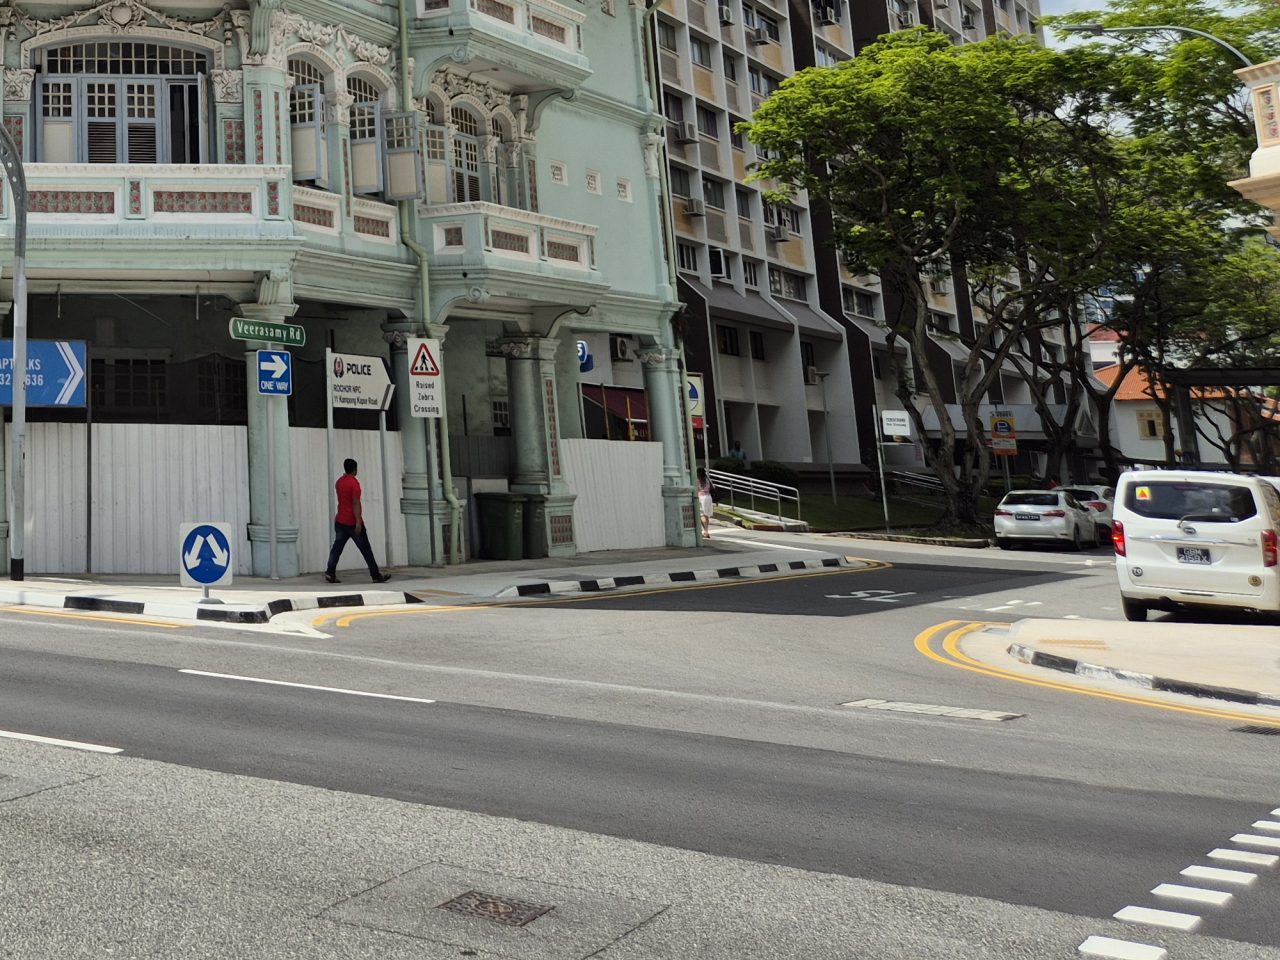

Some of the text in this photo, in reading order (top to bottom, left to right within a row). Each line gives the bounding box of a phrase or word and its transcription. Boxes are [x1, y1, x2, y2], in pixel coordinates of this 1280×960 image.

[237, 320, 301, 341] Veerasamy Rd
[346, 363, 372, 376] POLICE
[25, 374, 43, 386] 636
[416, 381, 434, 389] Raised
[260, 381, 288, 390] ONE WAY
[418, 393, 434, 401] Zebra
[414, 404, 439, 414] Crossing
